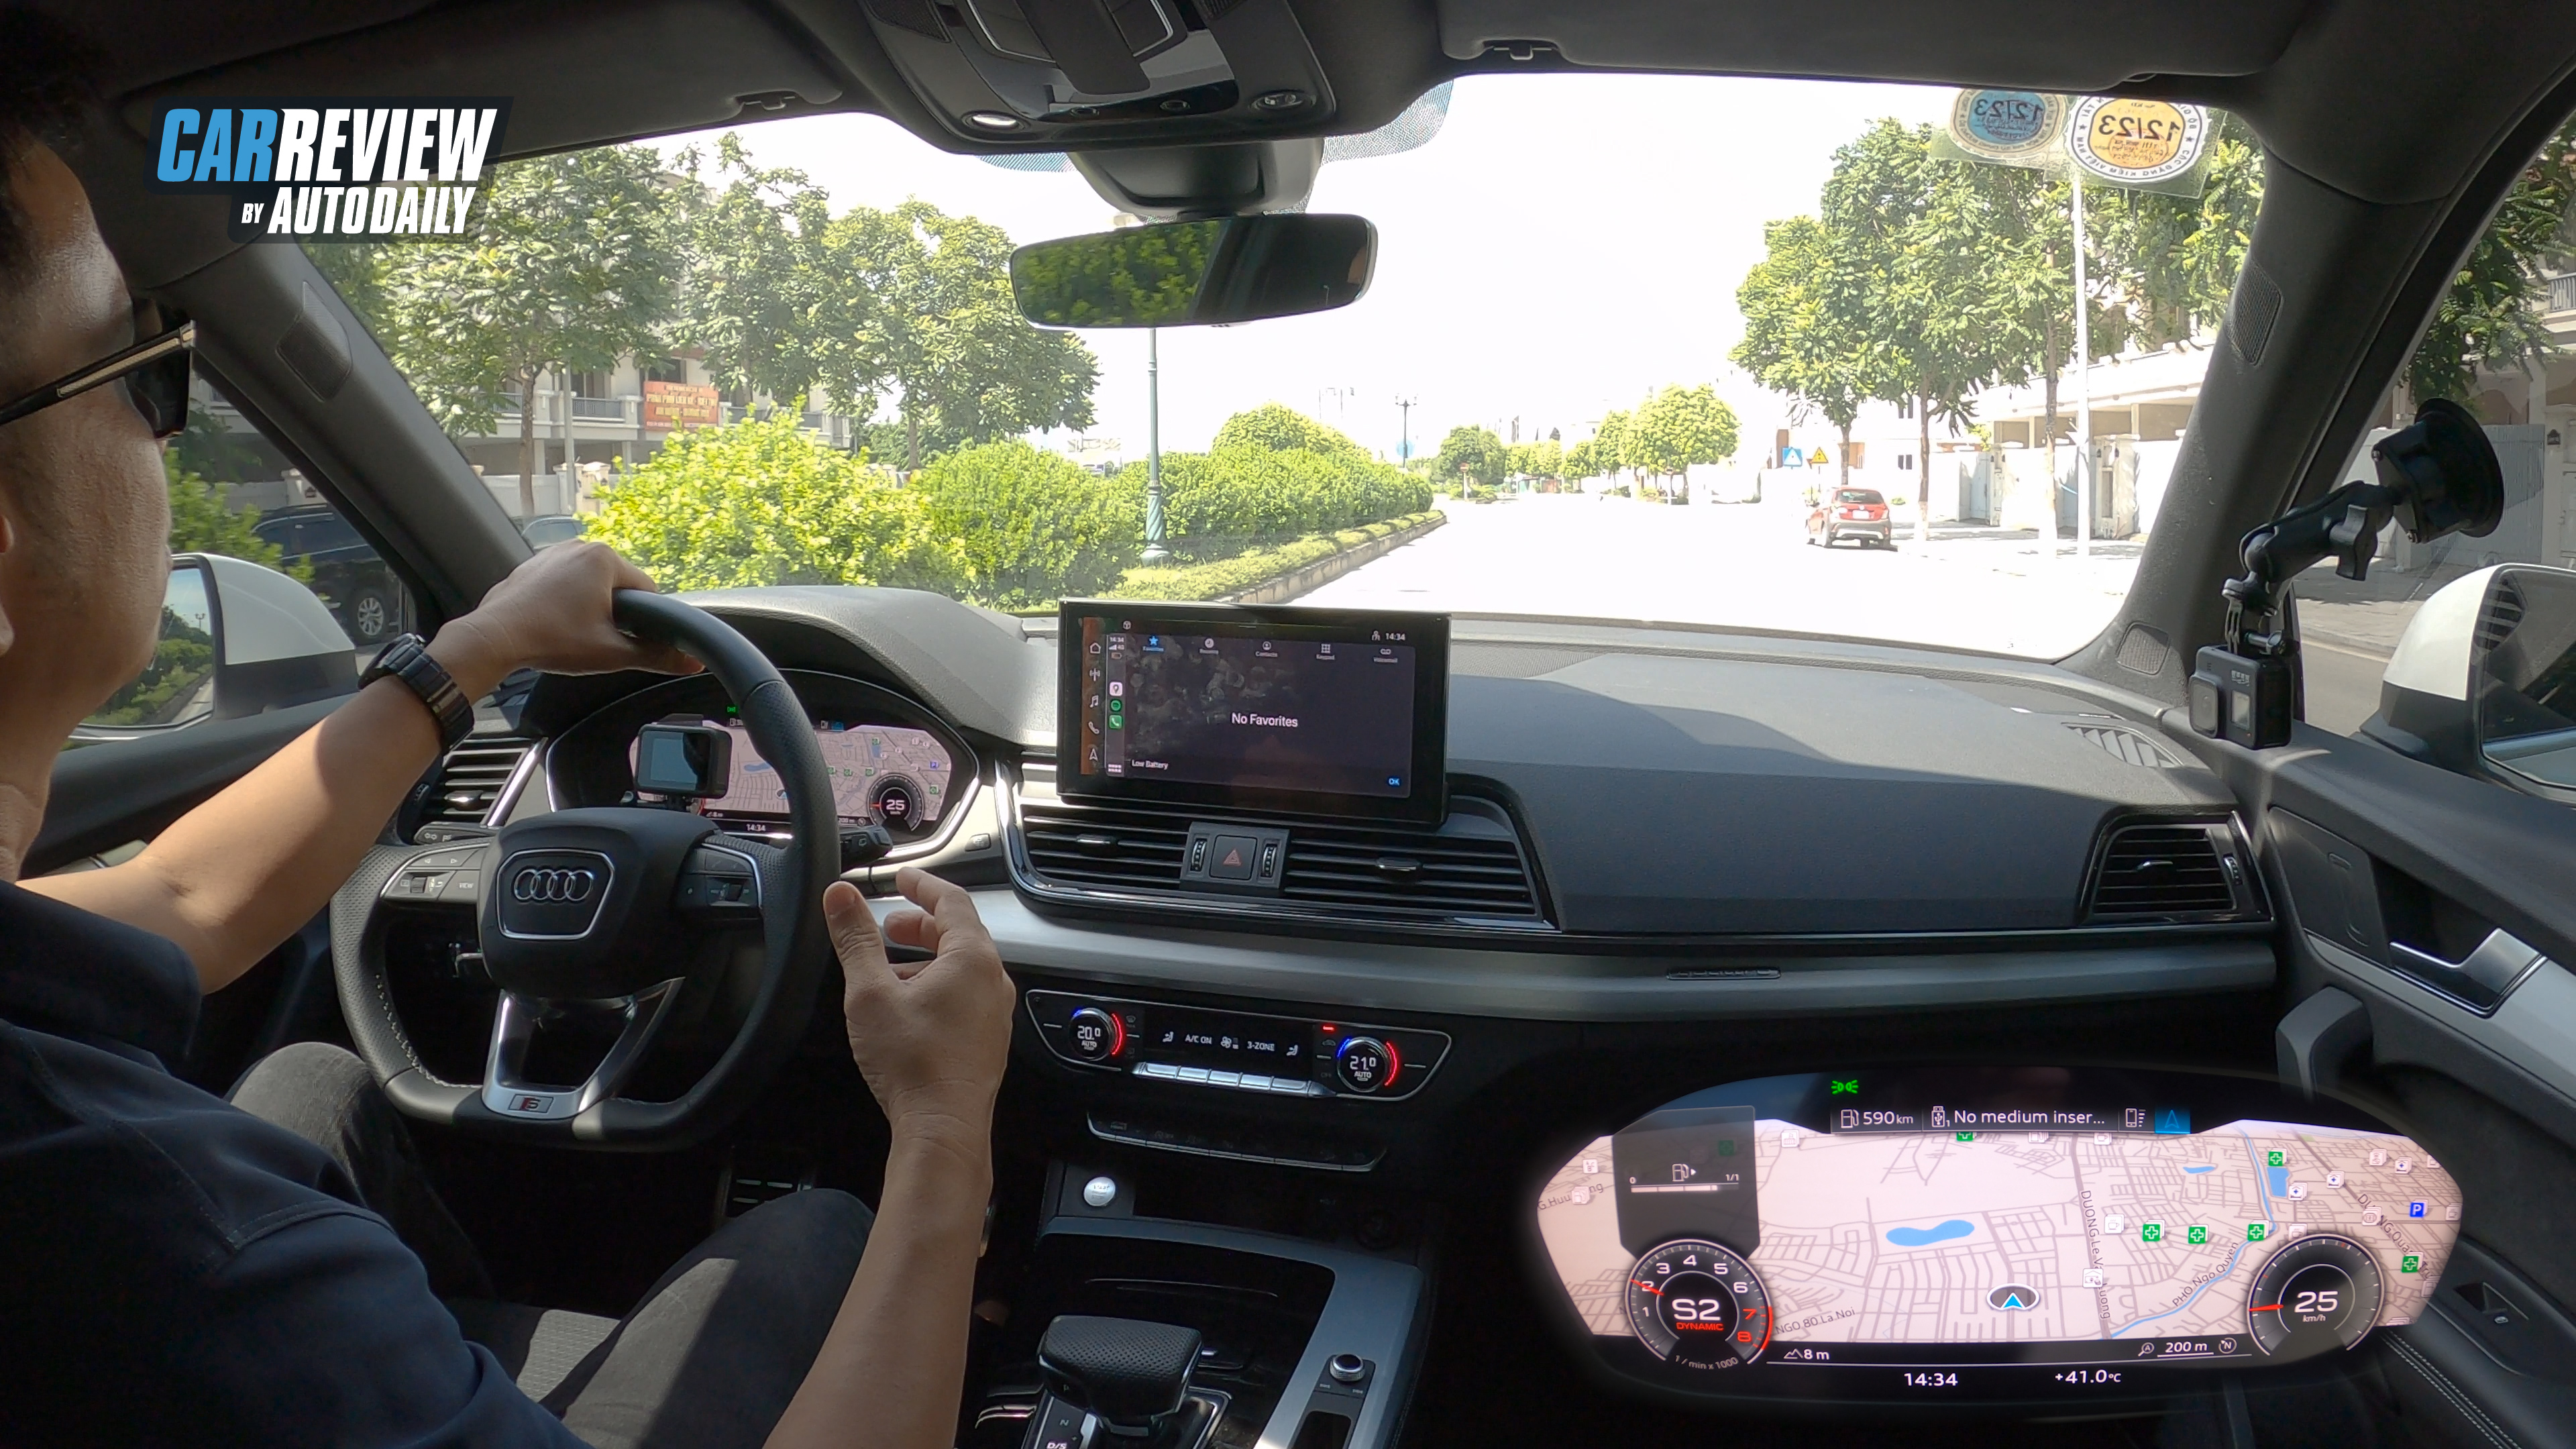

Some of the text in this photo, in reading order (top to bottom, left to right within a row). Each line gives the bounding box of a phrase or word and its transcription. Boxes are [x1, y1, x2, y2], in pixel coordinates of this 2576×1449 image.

[1232, 712, 1298, 729] No Favorites
[1132, 759, 1169, 771] Low Battery
[886, 799, 905, 810] 25
[1185, 1034, 1212, 1044] A/C ON
[1954, 1110, 1977, 1124] No
[1981, 1109, 2048, 1124] medium
[1725, 1173, 1740, 1181] 1/1
[2081, 1190, 2100, 1238] DUONG
[2091, 1240, 2101, 1254] Le
[1682, 1254, 1697, 1266] 4
[1656, 1263, 1670, 1275] 3
[1713, 1263, 1729, 1275] 5
[2171, 1242, 2239, 1307] PHO Ngo Quyen
[1641, 1281, 1655, 1292] 2
[1733, 1281, 1749, 1293] 6
[2294, 1291, 2339, 1313] 25
[1642, 1306, 1650, 1318] 1
[1672, 1298, 1721, 1321] S2
[1742, 1309, 1757, 1320] 7
[1775, 1306, 1856, 1335] NGO 80 La Noi
[2302, 1313, 2326, 1323] km/h
[1676, 1322, 1724, 1331] DYNAMIC
[1737, 1332, 1752, 1342] 8
[2165, 1341, 2208, 1353] 200 m
[1803, 1349, 1830, 1360] 8 m
[1688, 1360, 1707, 1370] min
[1715, 1356, 1739, 1369] 1000
[1904, 1373, 1958, 1387] 14:34
